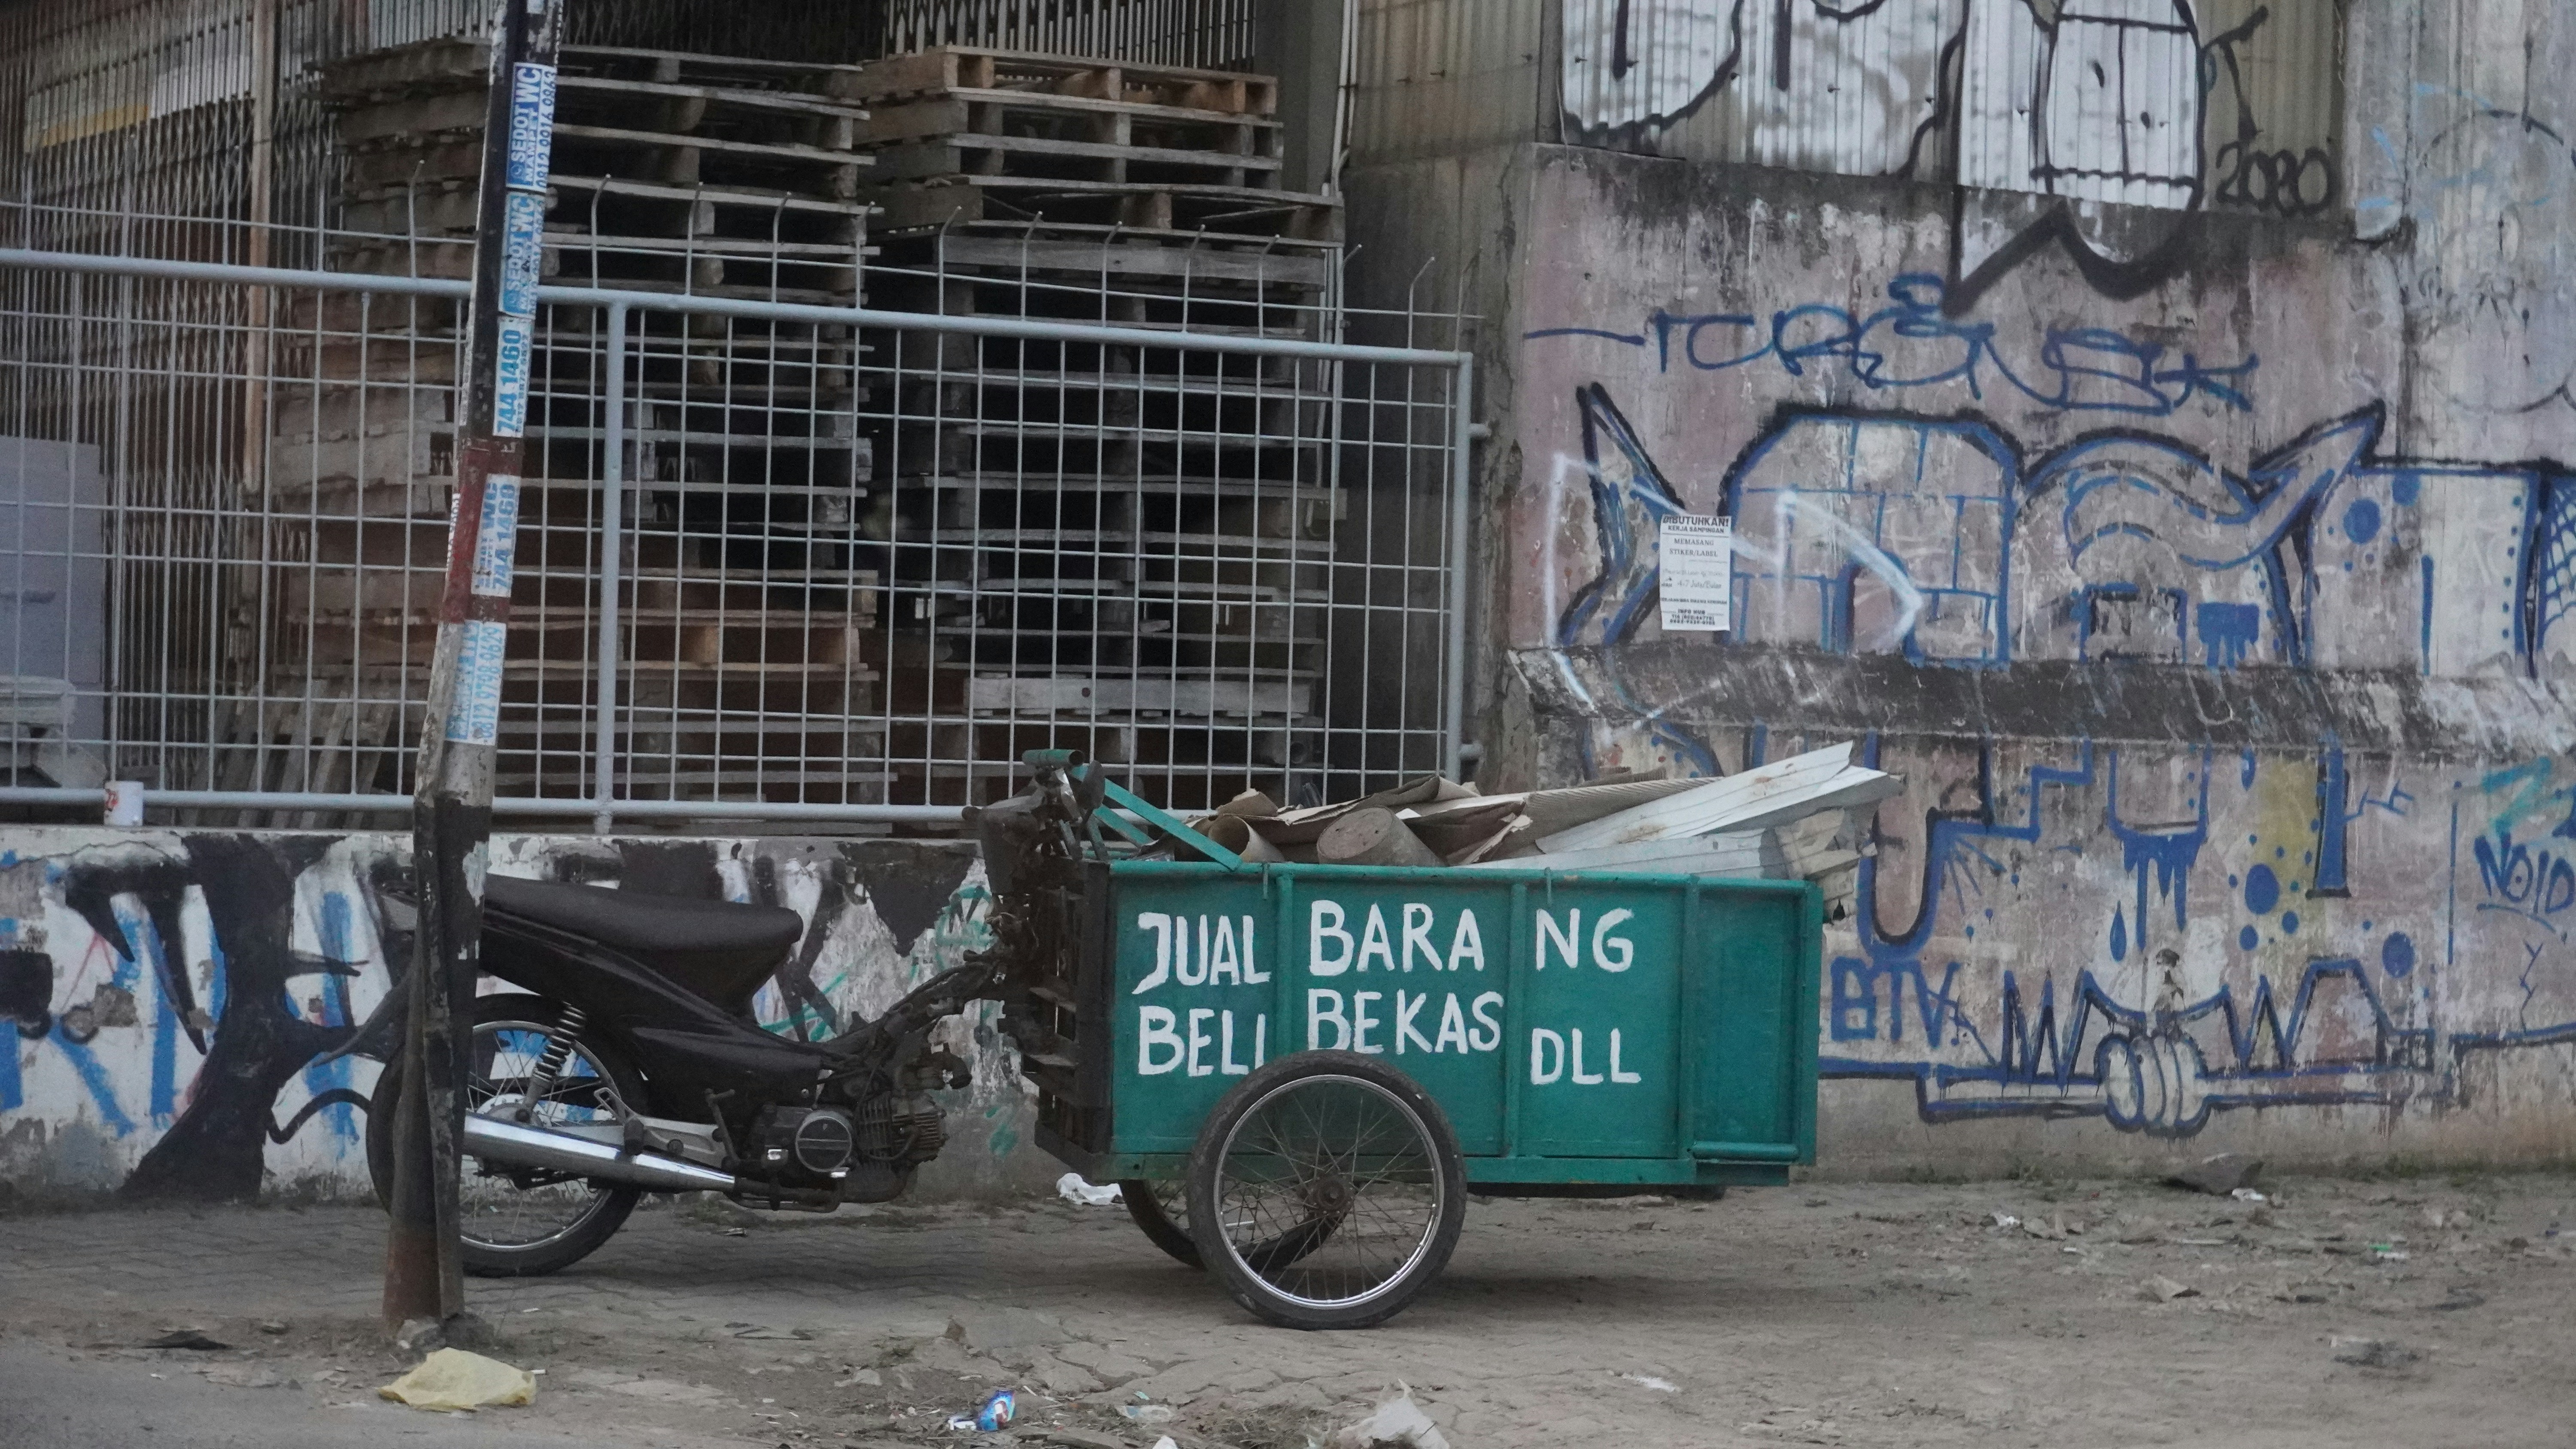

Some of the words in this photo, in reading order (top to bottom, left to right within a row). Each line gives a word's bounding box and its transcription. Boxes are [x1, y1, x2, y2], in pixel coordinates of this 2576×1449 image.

[516, 68, 542, 103] WC
[510, 105, 529, 162] SEDOT
[510, 197, 534, 232] WC
[507, 234, 523, 291] SEDOT
[501, 330, 521, 386] 1460
[497, 393, 516, 433] 744
[482, 483, 497, 529] WC
[496, 484, 515, 541] 1460
[1662, 516, 1729, 527] DIBUTUHKAN!
[492, 549, 511, 589] 744
[1669, 549, 1718, 557] STIKER/LABEL
[1132, 911, 1271, 994] JUAL
[1139, 1005, 1266, 1077] BELI
[1308, 988, 1504, 1055] BEKAS
[1531, 1028, 1642, 1085] DLL
